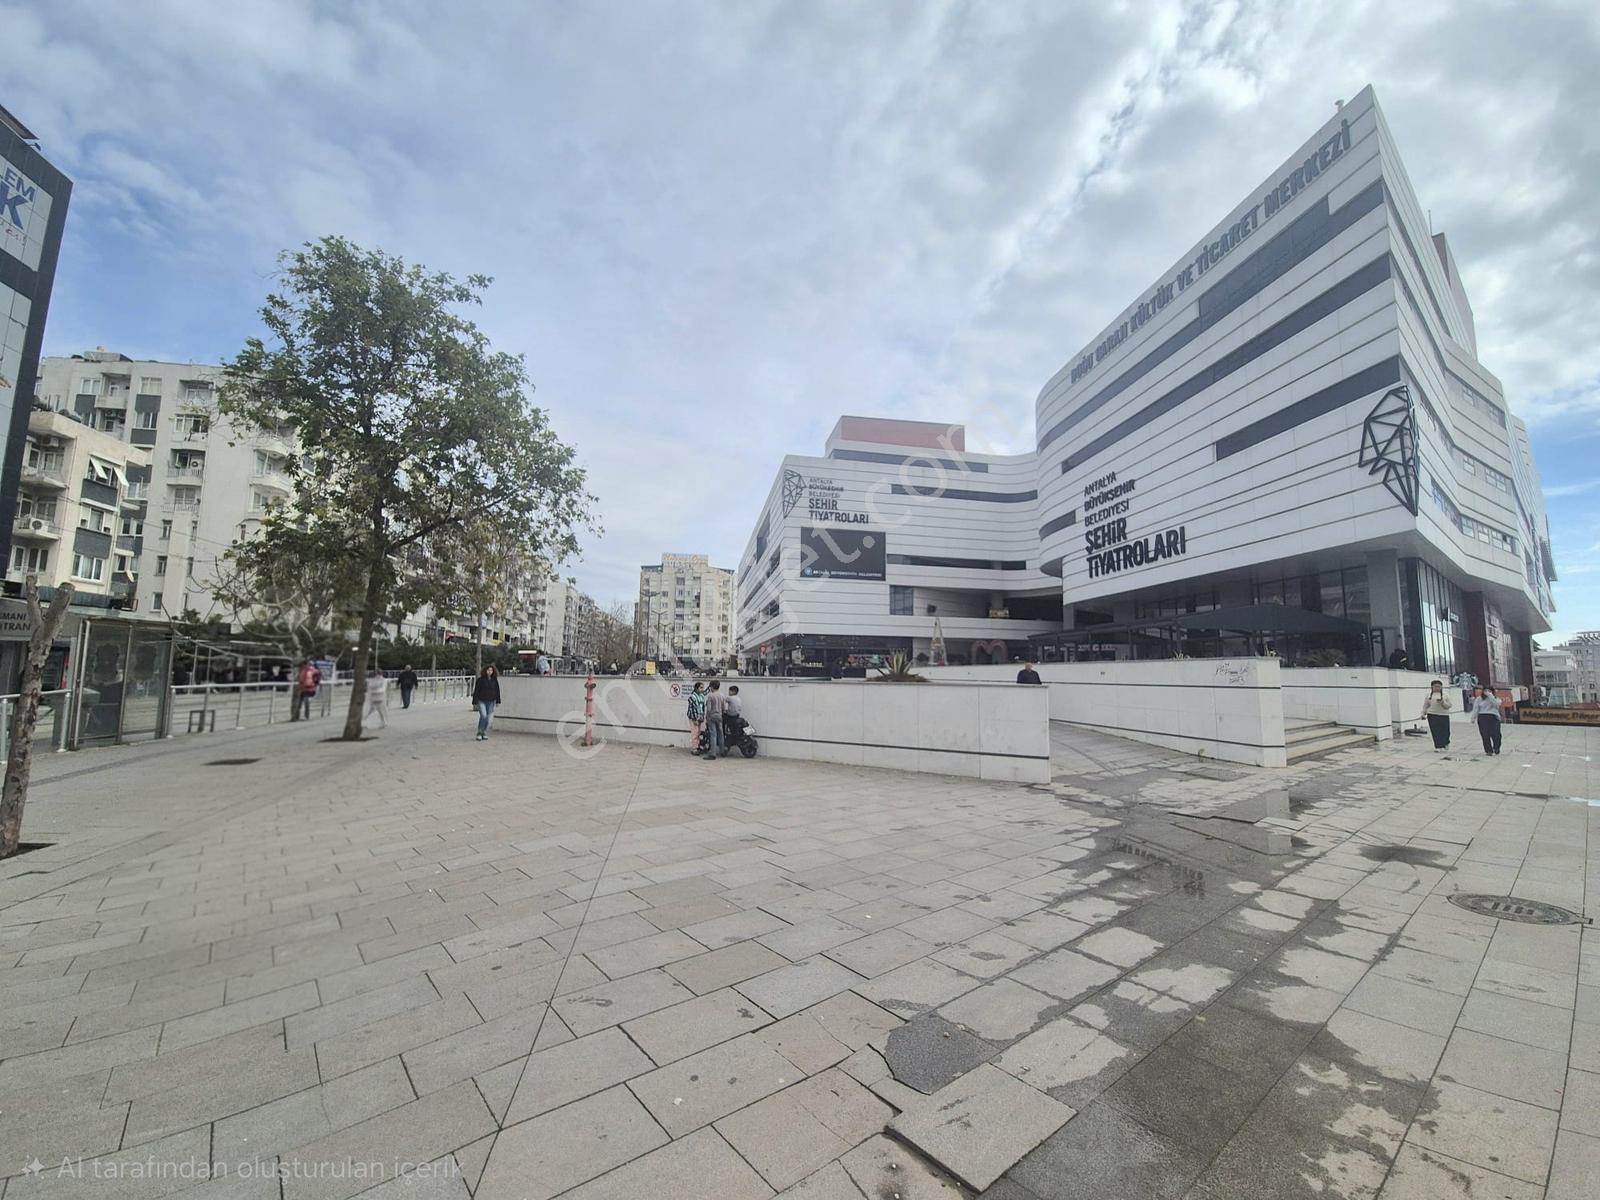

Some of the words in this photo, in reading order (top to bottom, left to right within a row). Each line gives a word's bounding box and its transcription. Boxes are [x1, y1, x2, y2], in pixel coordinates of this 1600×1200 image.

[0, 167, 35, 203] EM
[1130, 282, 1174, 333] KÜLTÜR
[1176, 263, 1194, 291] VE
[1264, 118, 1351, 218] MERKEZİ
[1084, 471, 1117, 497] ANTALYA
